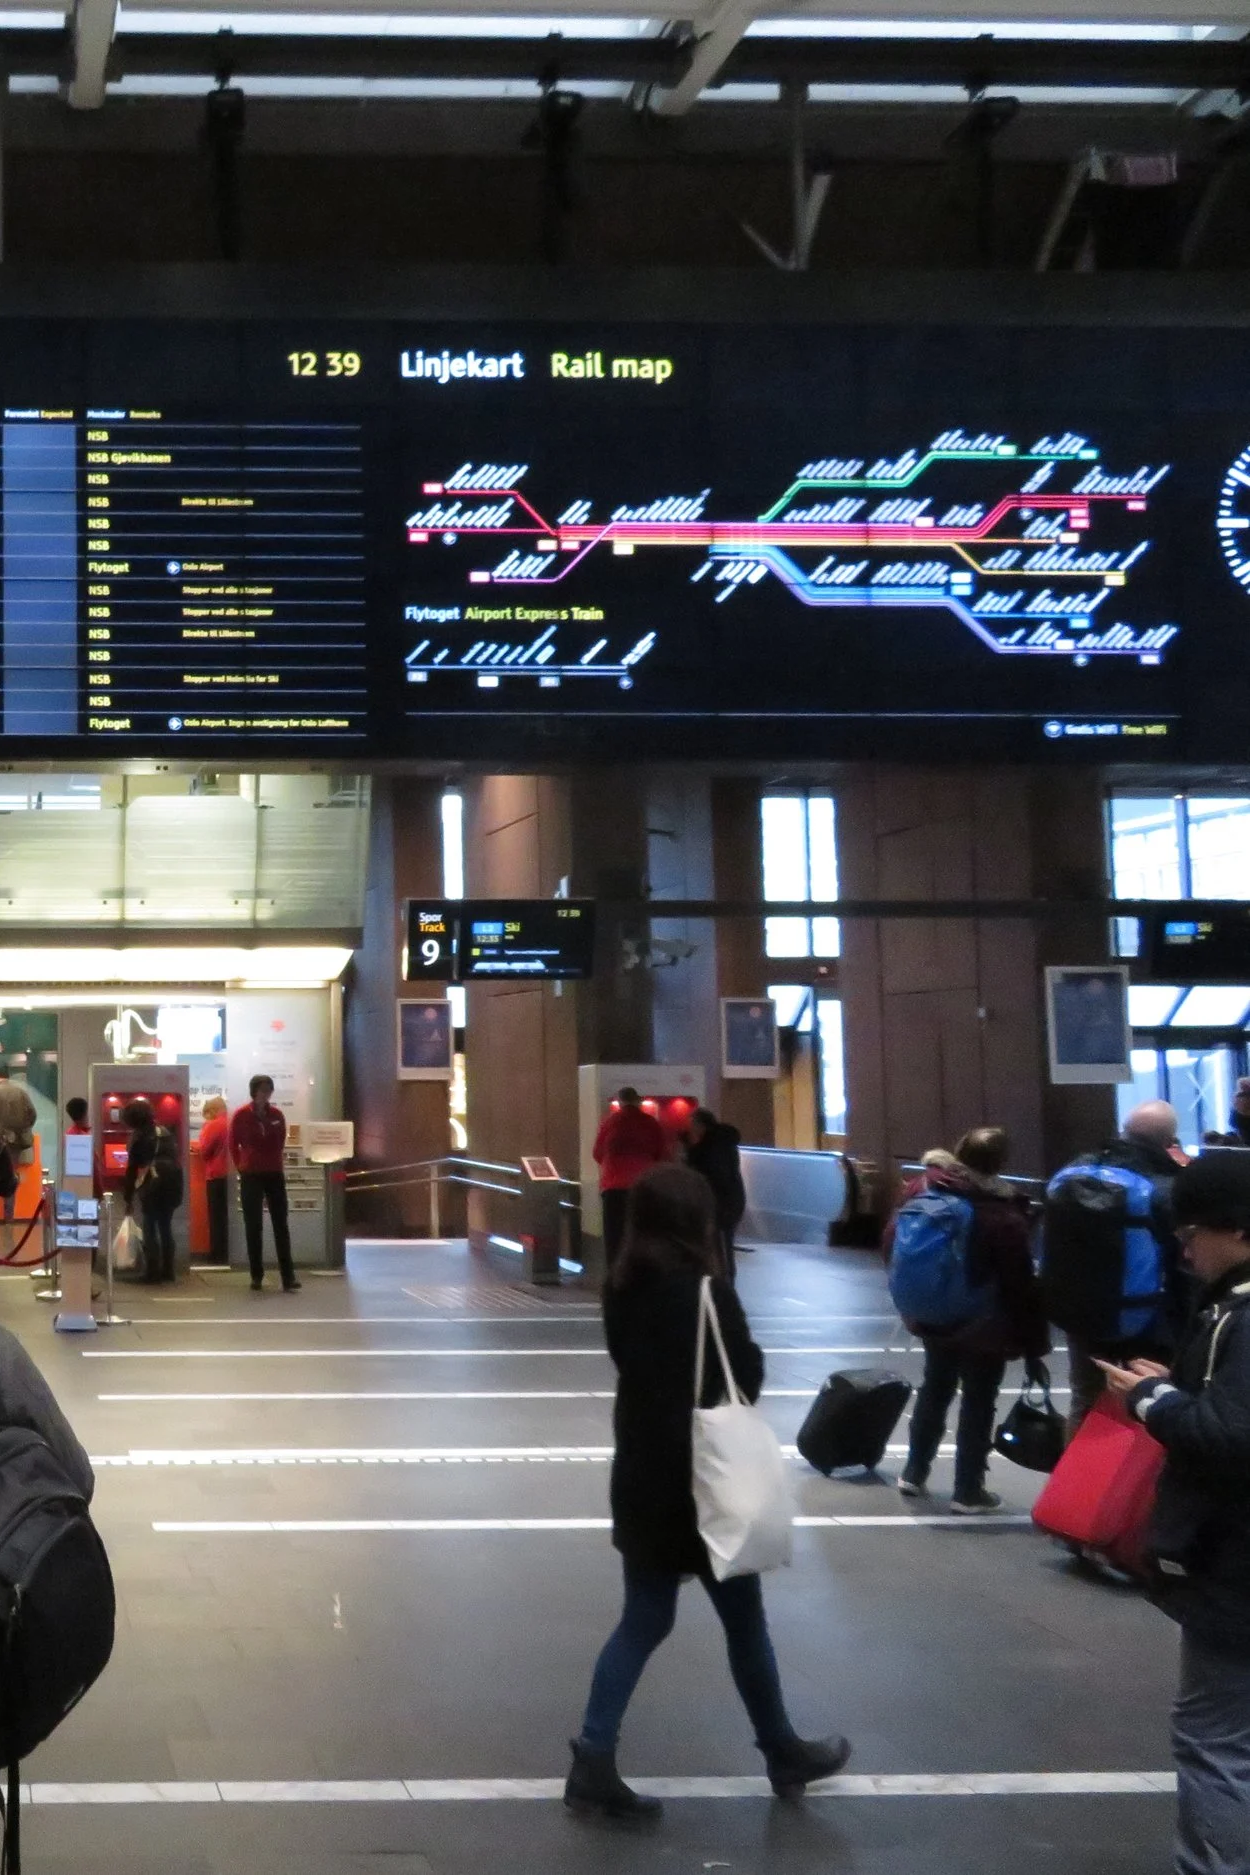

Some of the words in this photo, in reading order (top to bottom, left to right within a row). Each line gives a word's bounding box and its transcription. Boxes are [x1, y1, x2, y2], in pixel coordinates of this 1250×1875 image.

[288, 352, 316, 376] 12
[326, 353, 360, 376] 39
[402, 351, 524, 383] Linjekart
[552, 352, 604, 378] Rail
[612, 359, 672, 384] map
[88, 431, 108, 441] NSB
[88, 453, 109, 462] NSB
[88, 474, 109, 484] NSB
[88, 497, 109, 507] NSB
[88, 519, 109, 529] NSB
[88, 540, 109, 550] NSB
[89, 562, 129, 574] Flytoget
[89, 586, 110, 595] NSB
[89, 607, 110, 617] NSB
[406, 607, 460, 622] Flytoget
[465, 607, 512, 622] Airport
[515, 607, 568, 622] Express
[571, 607, 603, 620] Train
[89, 629, 110, 639] NSB
[89, 651, 110, 661] NSB
[90, 675, 110, 684] NSB
[90, 696, 111, 706] NSB
[90, 718, 130, 730] Flytoget
[419, 912, 442, 923] Spor
[419, 922, 446, 932] Track
[505, 922, 520, 932] Ski
[421, 939, 440, 966] 9
